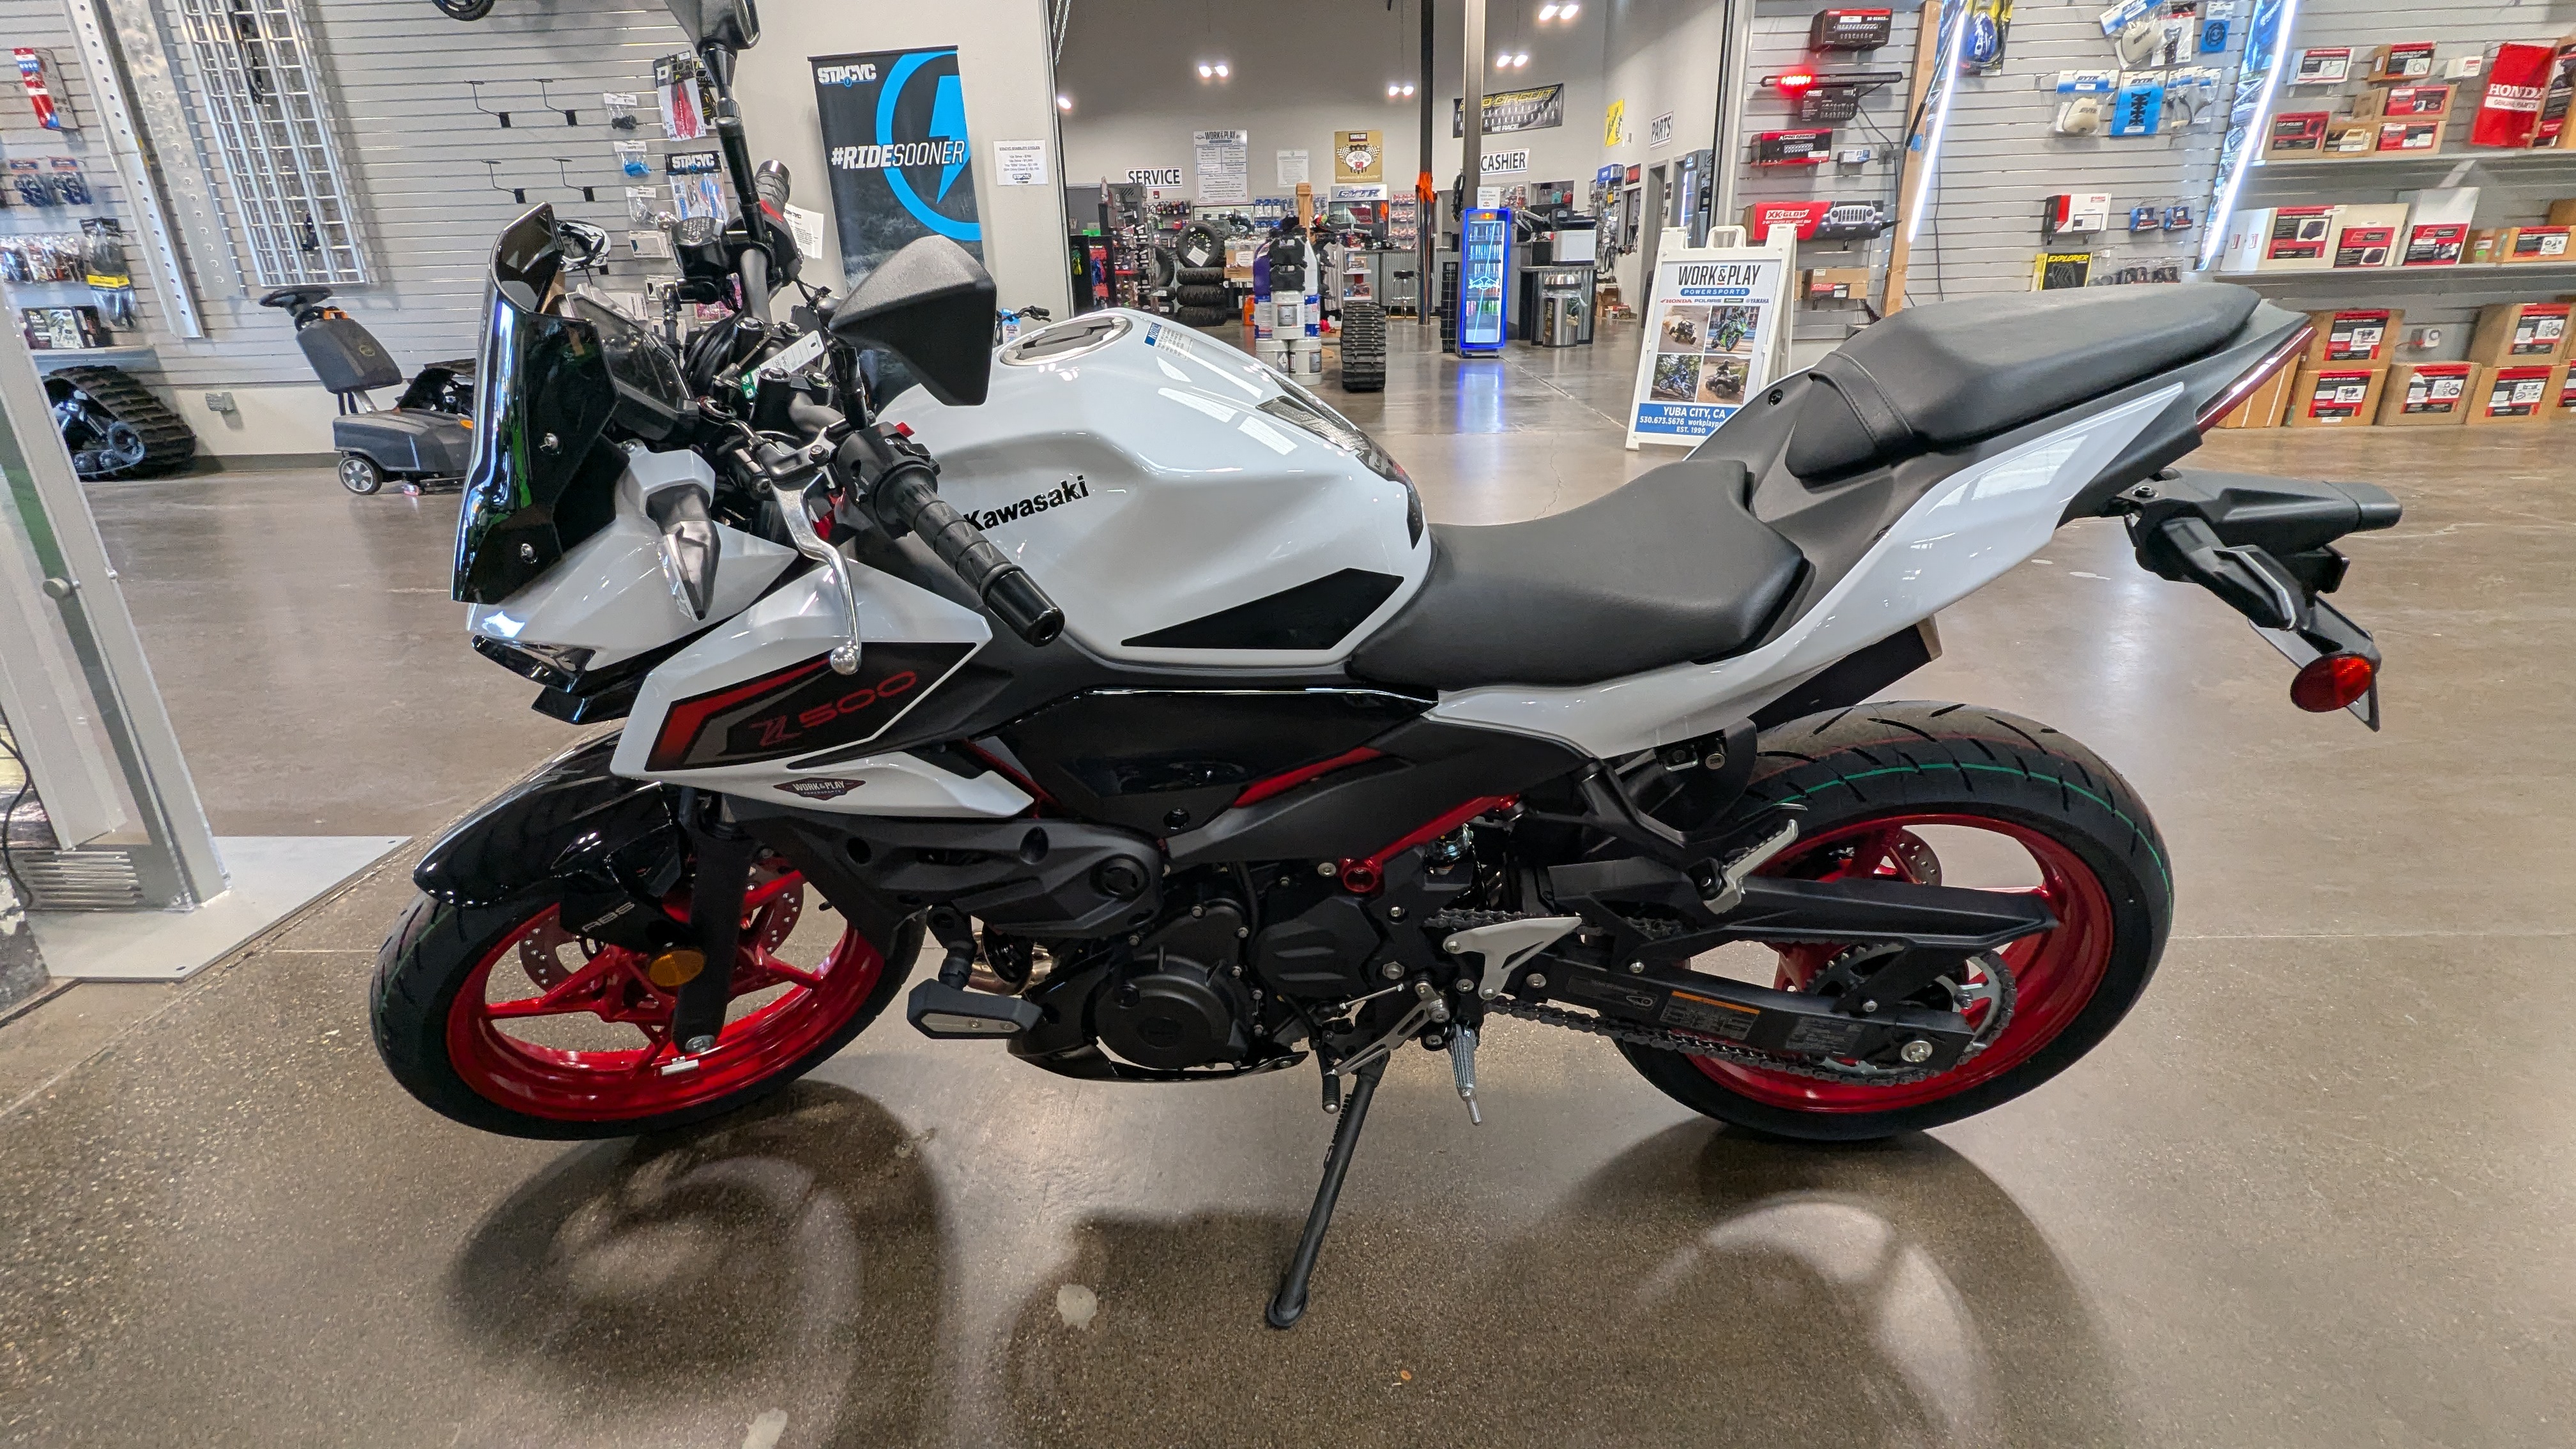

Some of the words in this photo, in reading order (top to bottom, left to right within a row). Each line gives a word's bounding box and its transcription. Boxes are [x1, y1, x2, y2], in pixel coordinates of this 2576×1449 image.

[817, 63, 877, 84] STACYC
[2516, 101, 2536, 109] PARTS
[1652, 115, 1671, 142] PARTS
[671, 153, 715, 169] STACYC
[831, 141, 965, 170] #RIDESOONER
[1480, 152, 1526, 171] CASHIER
[1128, 169, 1181, 185] SERVICE
[2048, 254, 2089, 263] EXPLORER
[1639, 416, 1685, 425] 530.673.5676
[1663, 406, 1687, 417] YUBA
[1689, 408, 1711, 418] CITY,
[1713, 409, 1726, 419] CA
[963, 475, 1089, 532] Kawasaki
[581, 901, 636, 933] ABS
